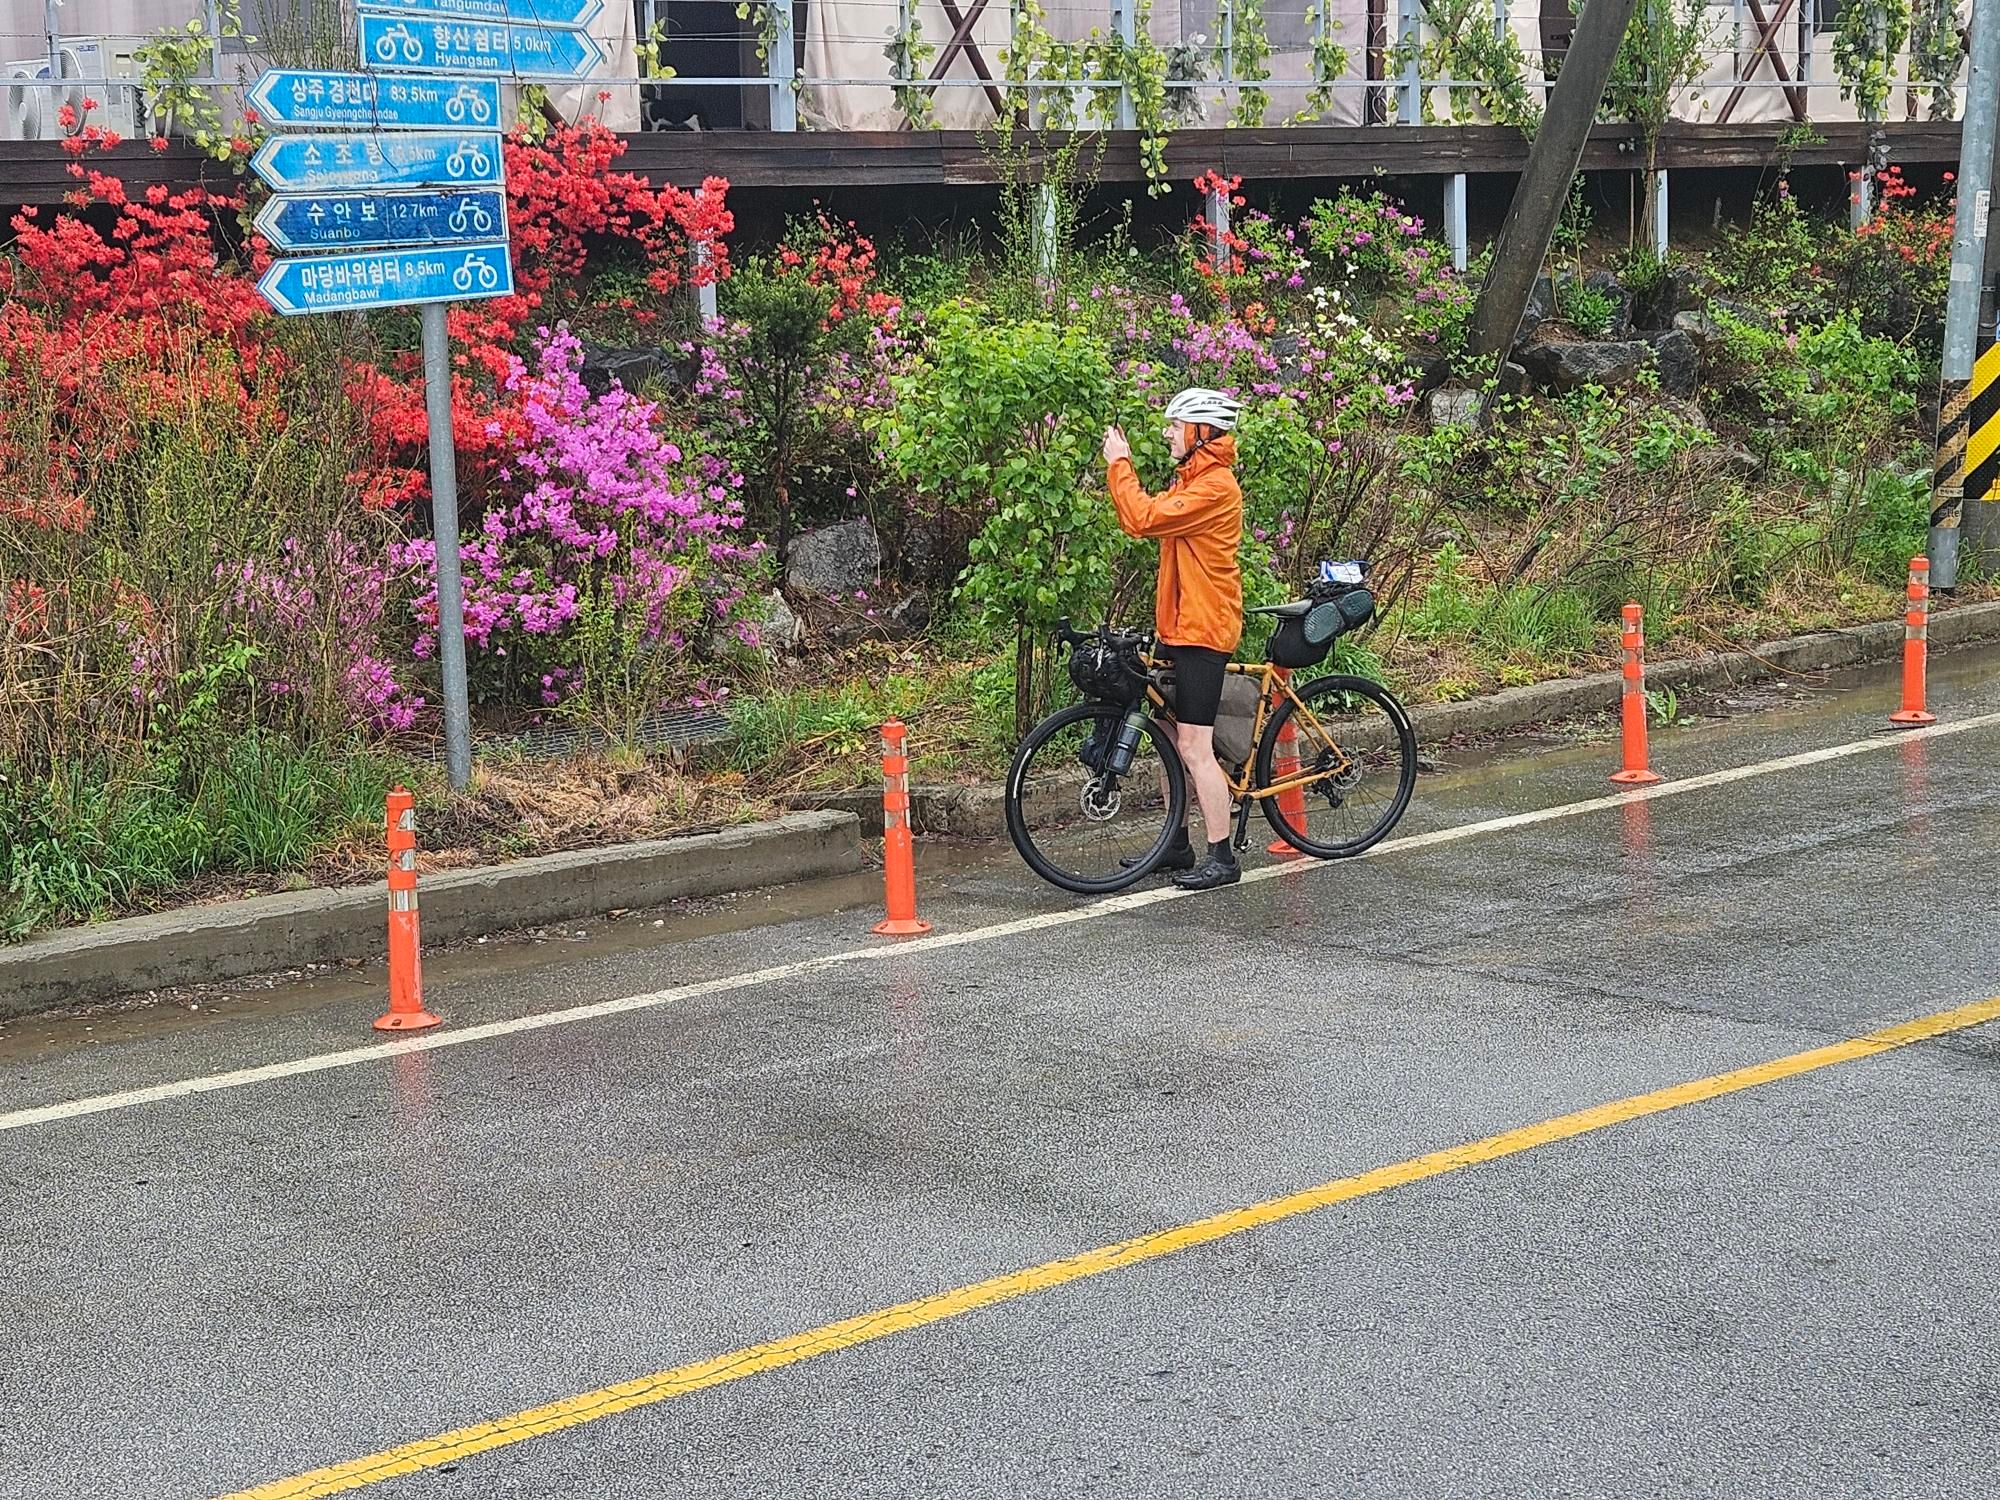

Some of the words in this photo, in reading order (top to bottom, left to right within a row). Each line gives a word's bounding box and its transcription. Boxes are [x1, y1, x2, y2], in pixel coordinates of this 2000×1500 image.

[513, 36, 551, 53] 5.0km
[435, 51, 498, 67] Hyangsan
[291, 78, 324, 103] 상주
[390, 85, 438, 103] 83.5km
[293, 104, 324, 120] Sangju
[391, 202, 439, 218] 12.7km
[310, 227, 361, 240] Suanbo
[301, 257, 401, 289] 마당바위쉼터
[404, 259, 446, 277] 8.5km
[303, 287, 380, 304] Madangbawi
